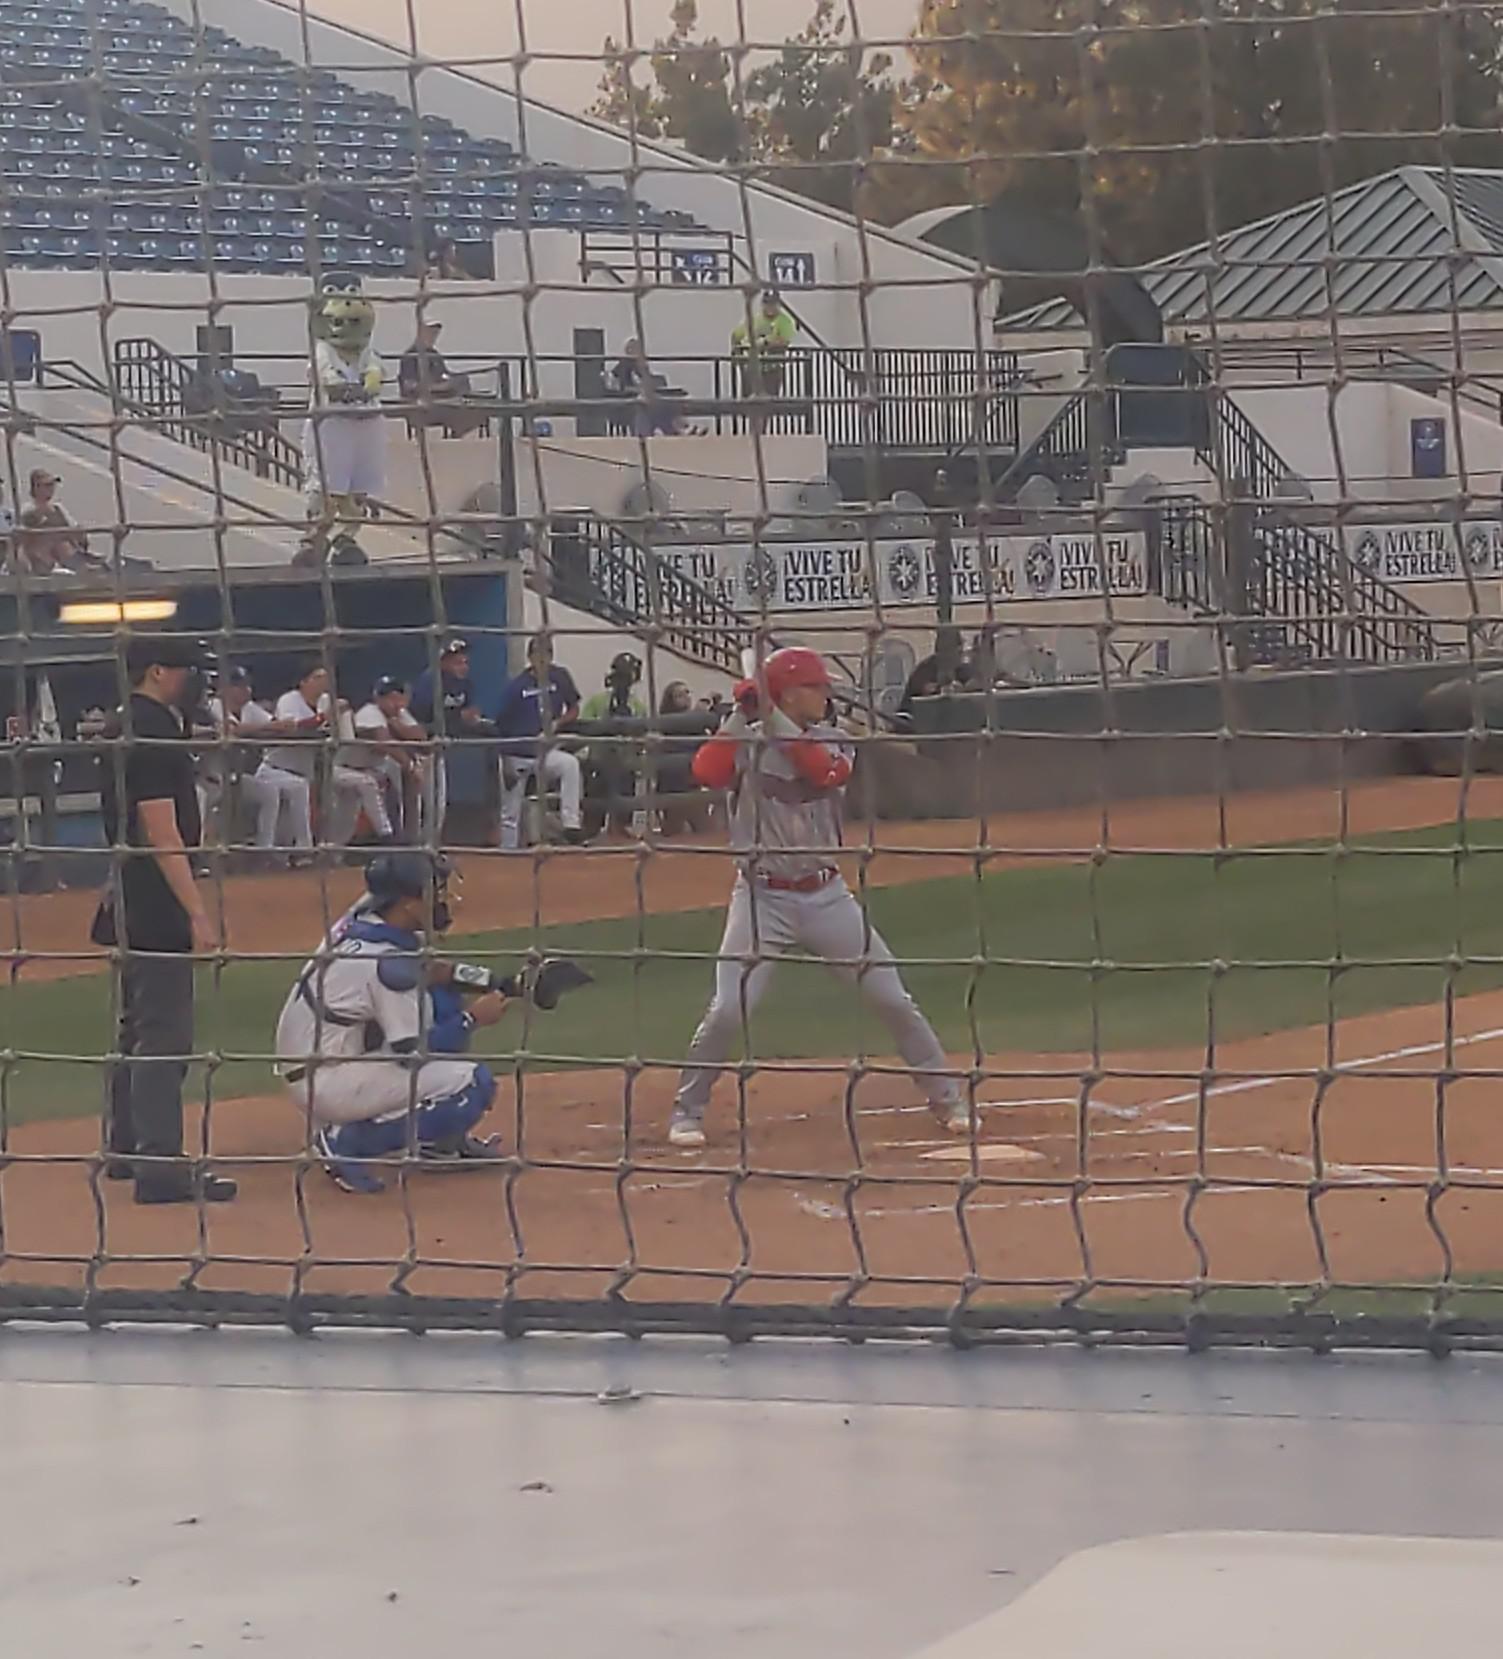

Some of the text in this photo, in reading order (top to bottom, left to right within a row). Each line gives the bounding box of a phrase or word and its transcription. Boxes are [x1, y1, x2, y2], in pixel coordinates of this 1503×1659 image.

[1426, 529, 1444, 551] TU
[689, 552, 715, 579] TU
[784, 548, 861, 576] ¡VIVE TU
